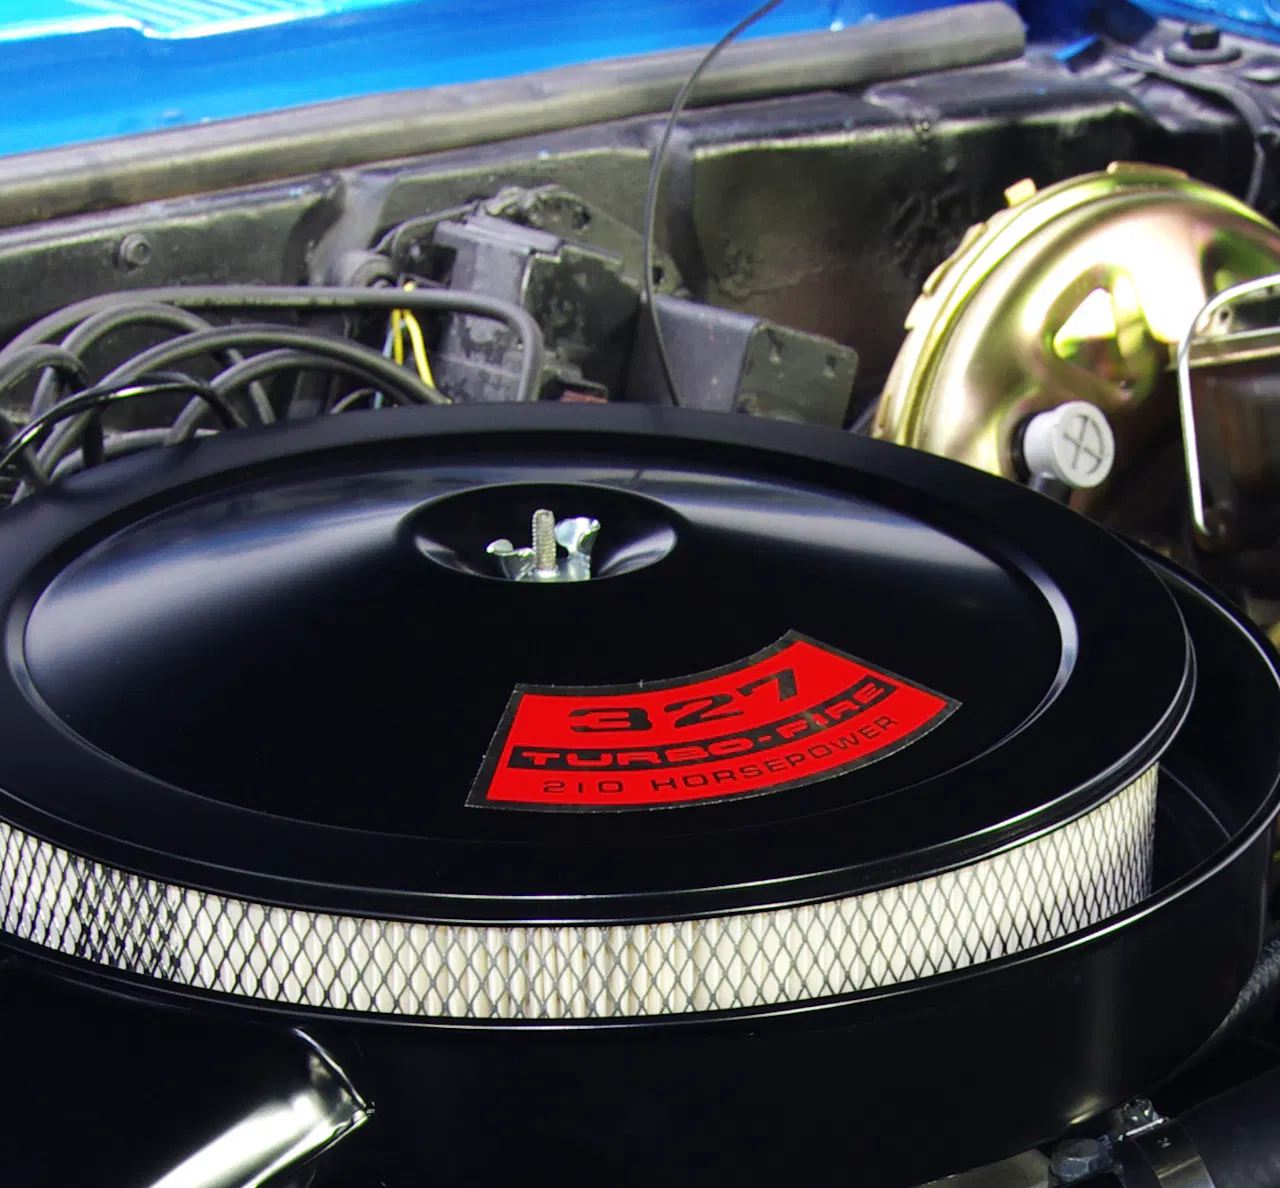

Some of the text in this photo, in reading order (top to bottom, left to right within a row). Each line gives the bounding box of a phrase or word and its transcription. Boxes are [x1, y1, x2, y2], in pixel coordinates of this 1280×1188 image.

[521, 682, 887, 768] TURBO-FIRE
[568, 669, 799, 732] 327
[542, 715, 899, 795] 210 HORSEPOWER
